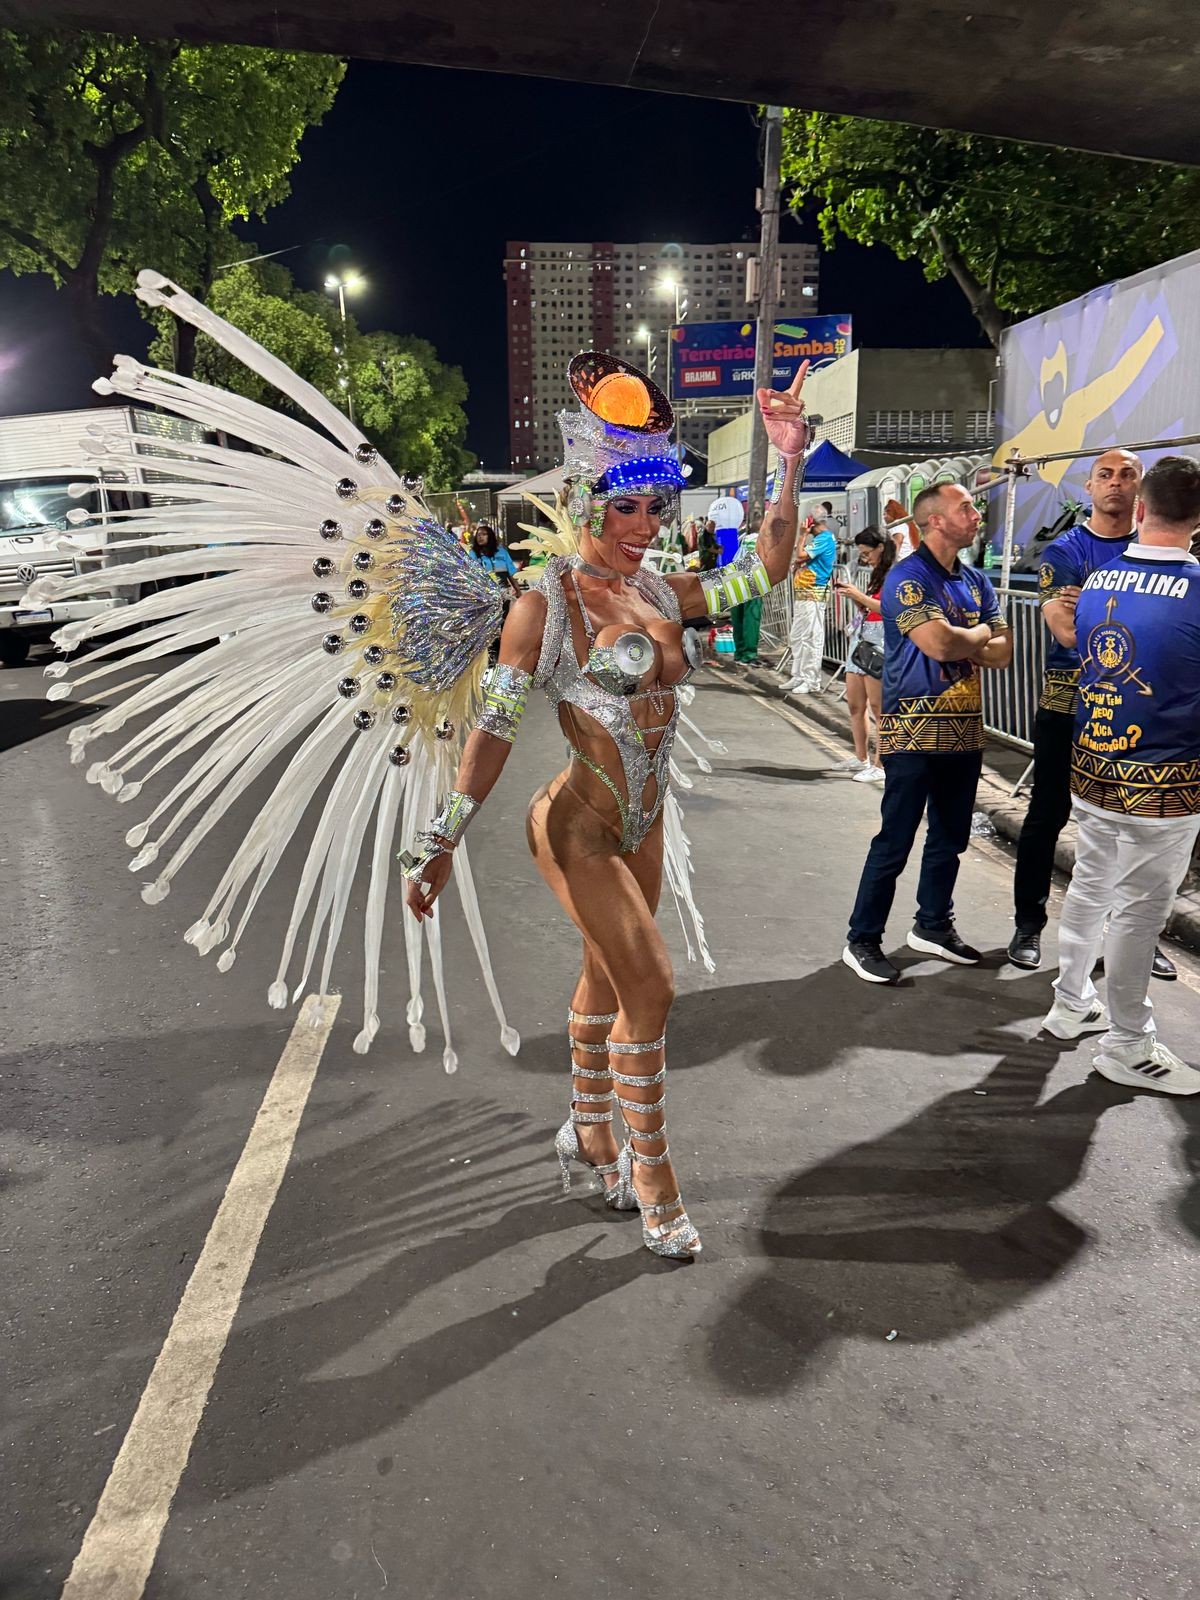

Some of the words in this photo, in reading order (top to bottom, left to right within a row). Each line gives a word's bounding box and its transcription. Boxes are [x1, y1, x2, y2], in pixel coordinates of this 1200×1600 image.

[679, 344, 755, 362] Terreirão
[773, 340, 834, 358] Samba
[834, 338, 846, 346] 20
[834, 346, 846, 354] 25
[684, 370, 717, 383] BRAHMA
[1081, 570, 1189, 599] DISCIPLINA
[1091, 706, 1114, 721] MEDO
[1090, 722, 1113, 736] XICA
